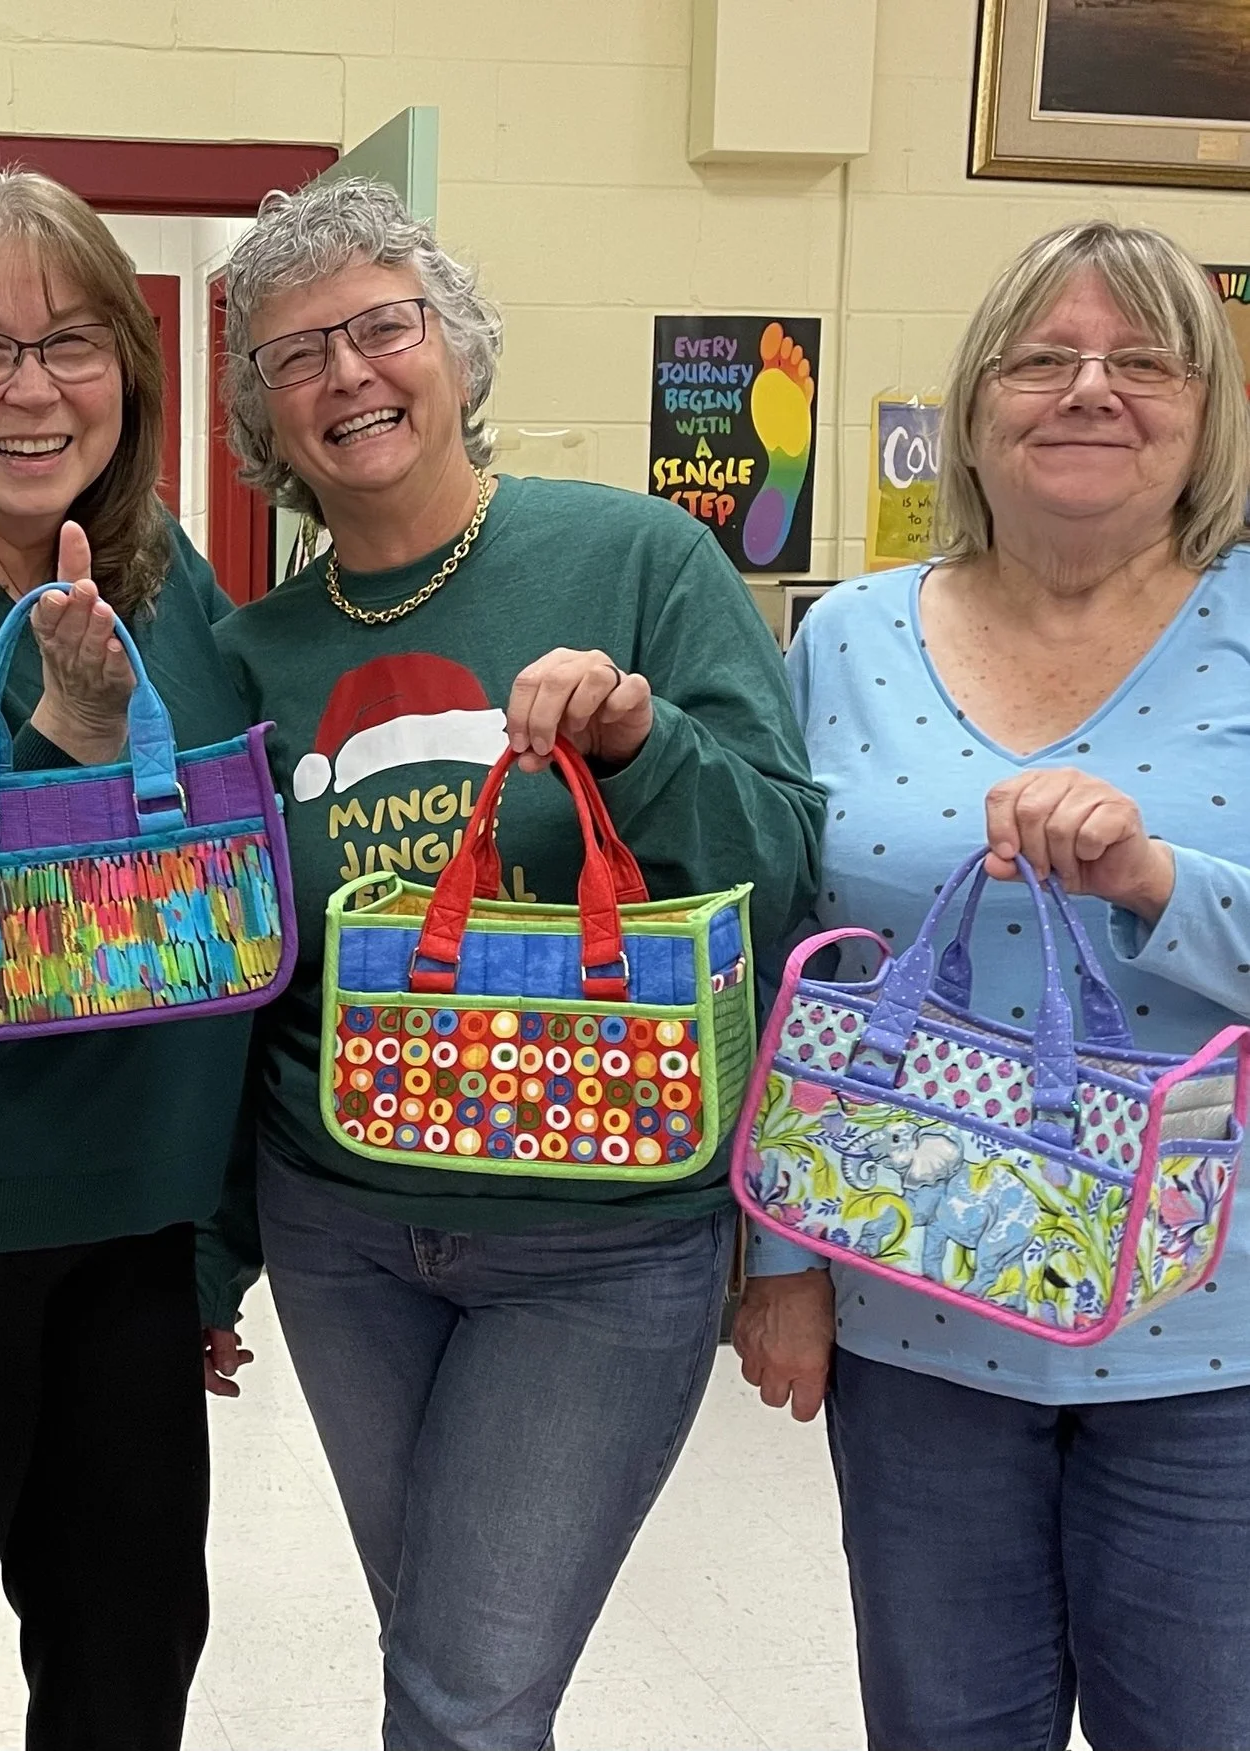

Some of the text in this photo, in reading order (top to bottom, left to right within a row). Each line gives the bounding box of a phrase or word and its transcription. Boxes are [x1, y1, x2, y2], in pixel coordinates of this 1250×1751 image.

[674, 335, 738, 361] EVERY
[657, 361, 754, 388] JOURNEY
[664, 387, 743, 415] BEGINS
[676, 416, 731, 436] WITH
[695, 435, 713, 459] A
[653, 457, 756, 492] SINGLE
[902, 496, 912, 508] is
[907, 511, 922, 525] to
[907, 530, 930, 543] and
[329, 772, 508, 839] MINGL
